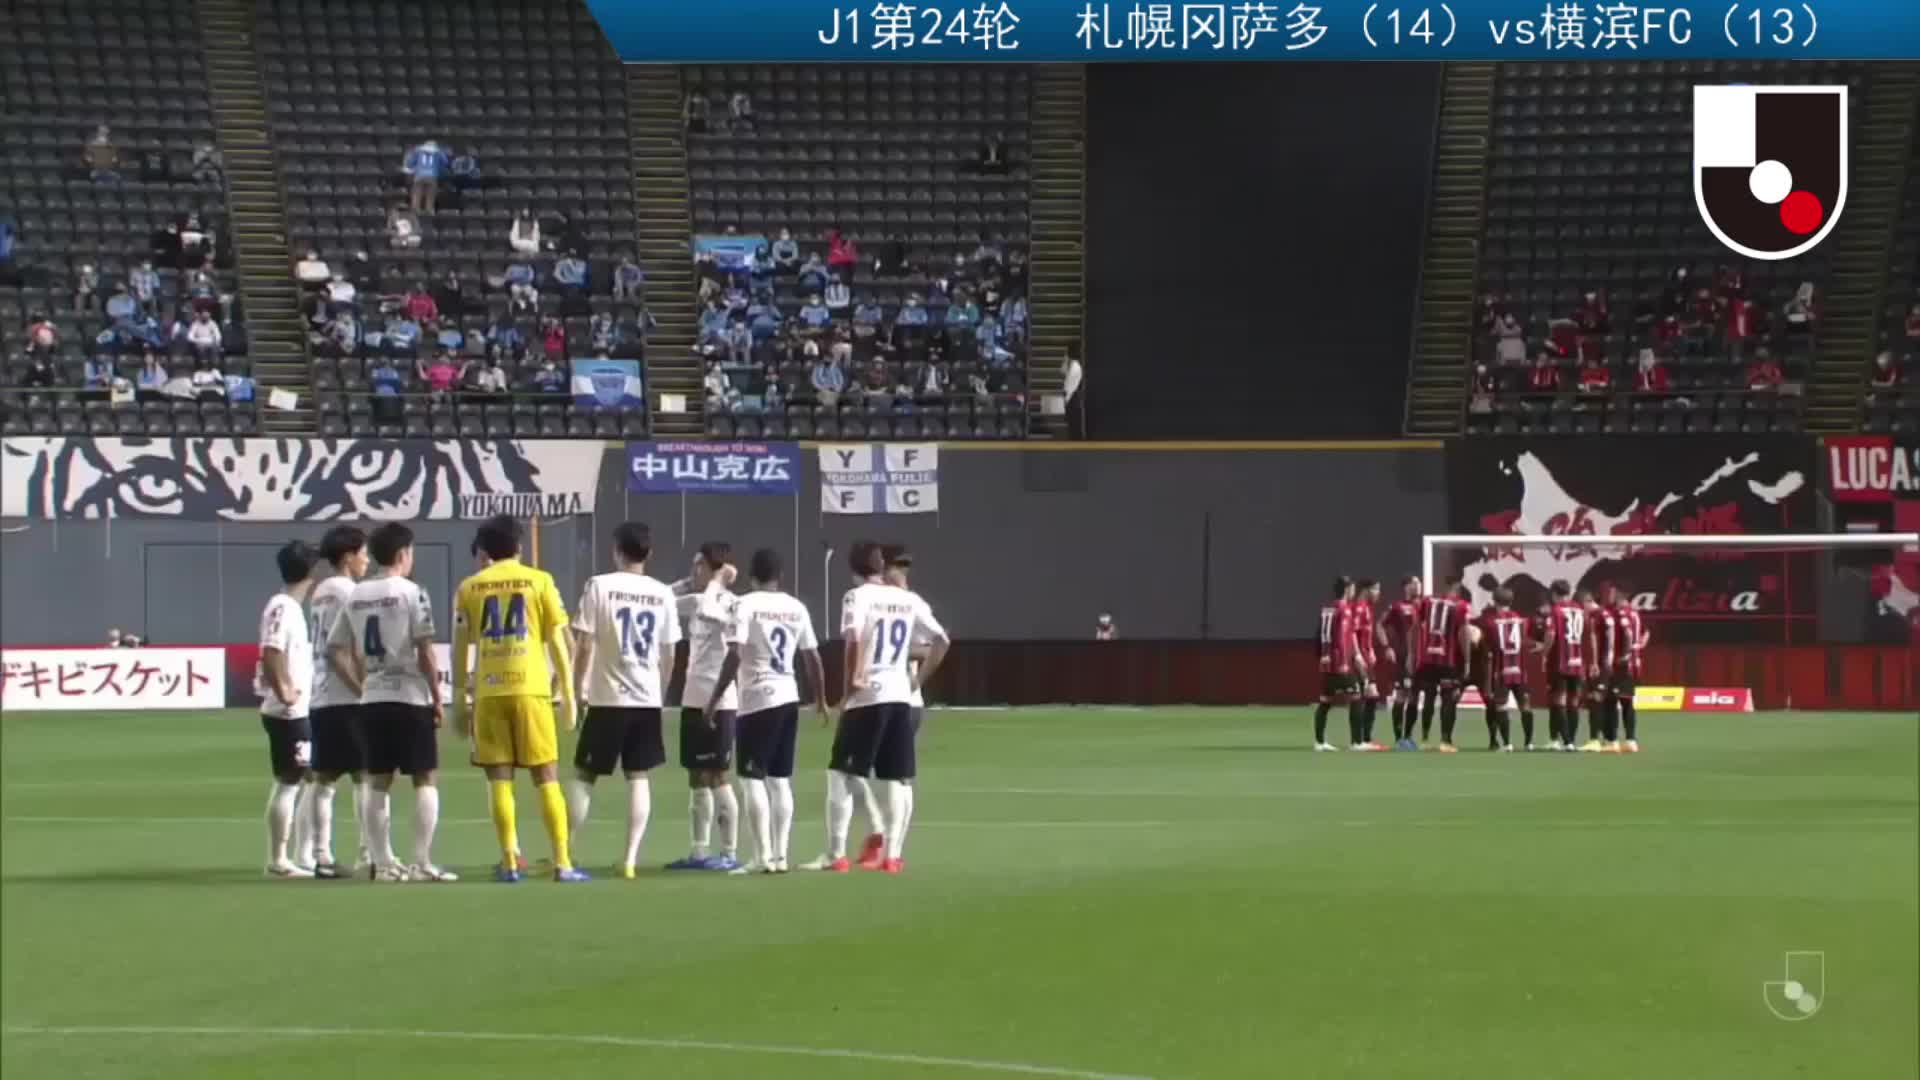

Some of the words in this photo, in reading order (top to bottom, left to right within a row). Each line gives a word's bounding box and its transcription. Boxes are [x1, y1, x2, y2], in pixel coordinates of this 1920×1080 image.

[632, 453, 790, 481] 中山克広
[836, 448, 856, 469] Y
[904, 449, 919, 468] F
[840, 491, 856, 509] F
[903, 489, 920, 507] C
[364, 614, 387, 663] 4
[481, 593, 528, 643] 44
[616, 606, 656, 660] 13
[872, 617, 908, 666] 19
[769, 626, 787, 674] 3
